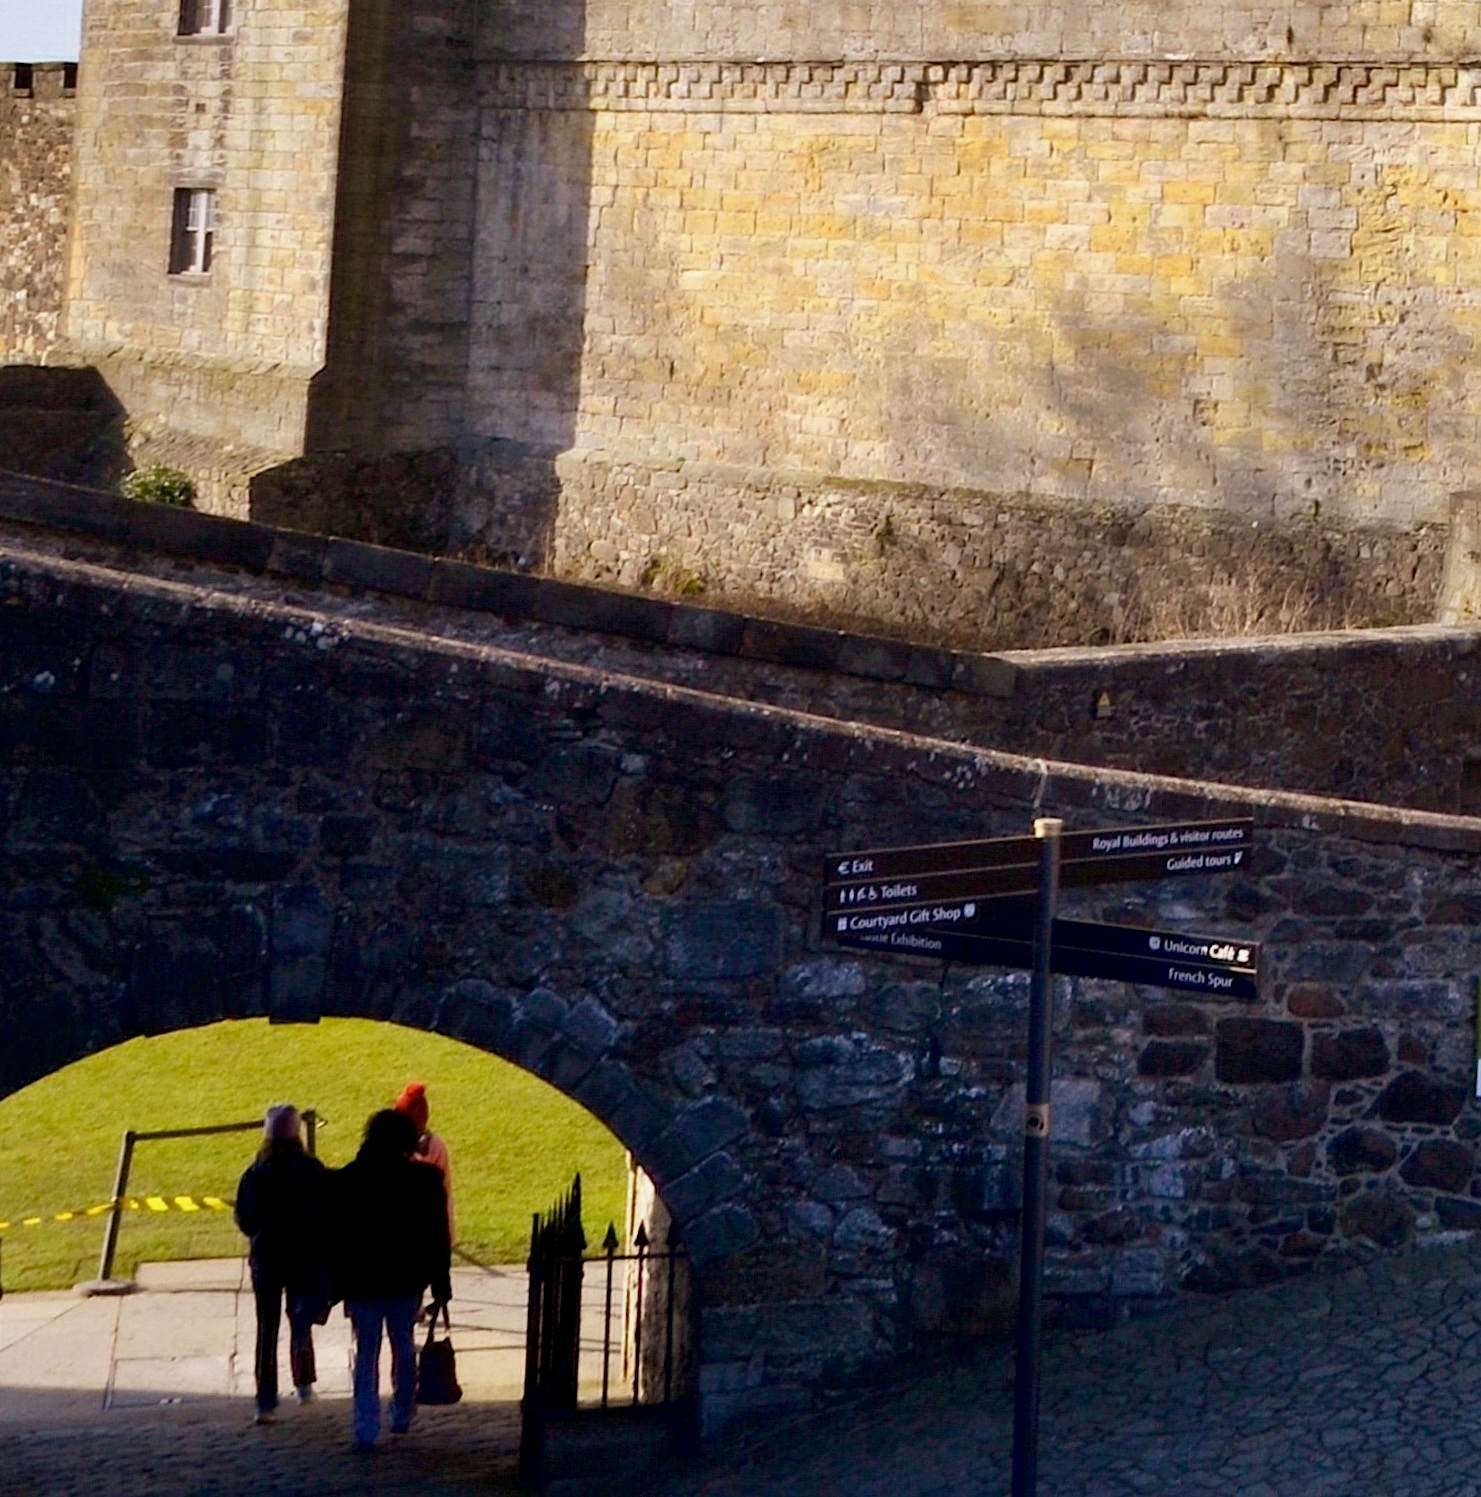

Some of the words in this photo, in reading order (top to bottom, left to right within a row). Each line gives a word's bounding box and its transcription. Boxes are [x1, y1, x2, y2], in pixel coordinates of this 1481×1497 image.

[1092, 836, 1120, 852] Royal
[1122, 833, 1168, 848] Buildings
[1169, 832, 1178, 843] &
[1179, 829, 1209, 842] visitor
[1211, 828, 1243, 840] routes
[852, 859, 874, 874] Exit
[1166, 855, 1202, 870] Guided
[1205, 854, 1231, 867] tours
[880, 884, 917, 898] Toilets
[850, 911, 907, 929] Courtyard
[909, 908, 930, 923] Gift
[932, 905, 961, 921] Shop
[891, 933, 942, 950] Exhibition
[1164, 939, 1208, 956] Unicorn
[1168, 967, 1205, 984] French
[1207, 973, 1233, 988] Spur
